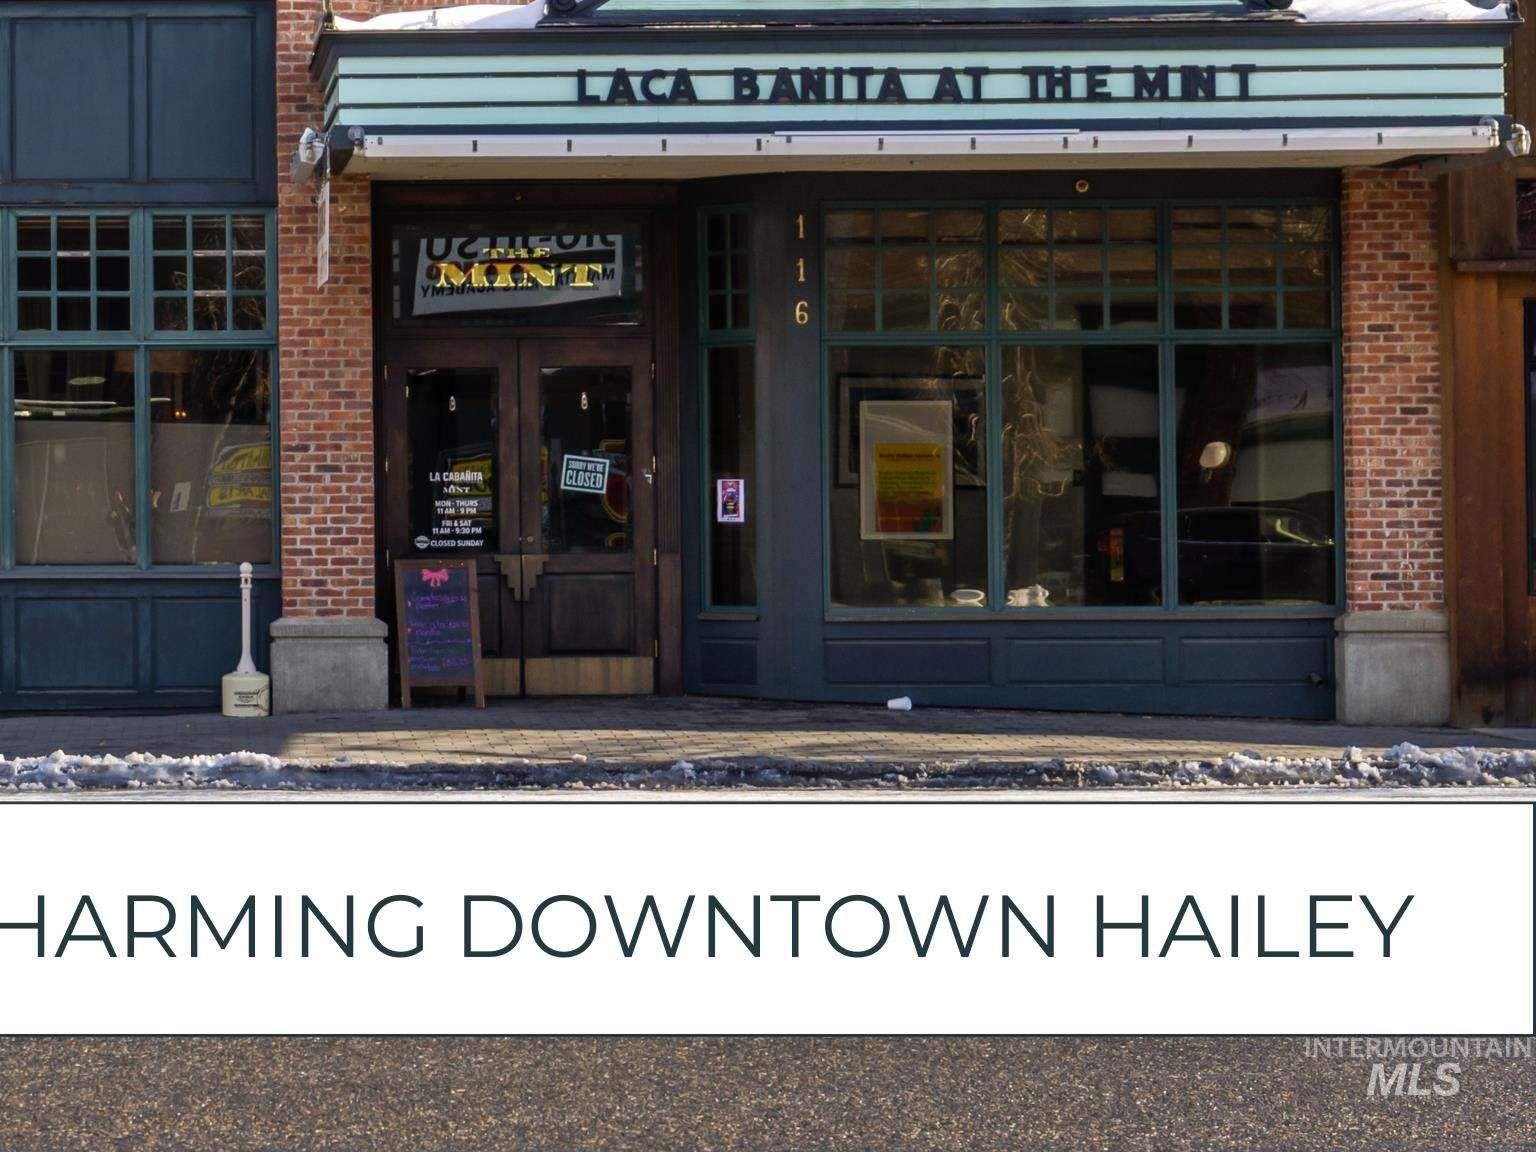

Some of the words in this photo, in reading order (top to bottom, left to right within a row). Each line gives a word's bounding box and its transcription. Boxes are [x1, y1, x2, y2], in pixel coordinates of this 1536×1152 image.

[933, 67, 989, 103] AT
[1022, 66, 1112, 102] THE
[1134, 64, 1257, 101] MINT
[482, 247, 552, 259] THE
[435, 262, 603, 288] MINT
[429, 472, 440, 481] LA
[443, 470, 483, 481] CABAÑITA
[566, 470, 602, 488] CLOSED
